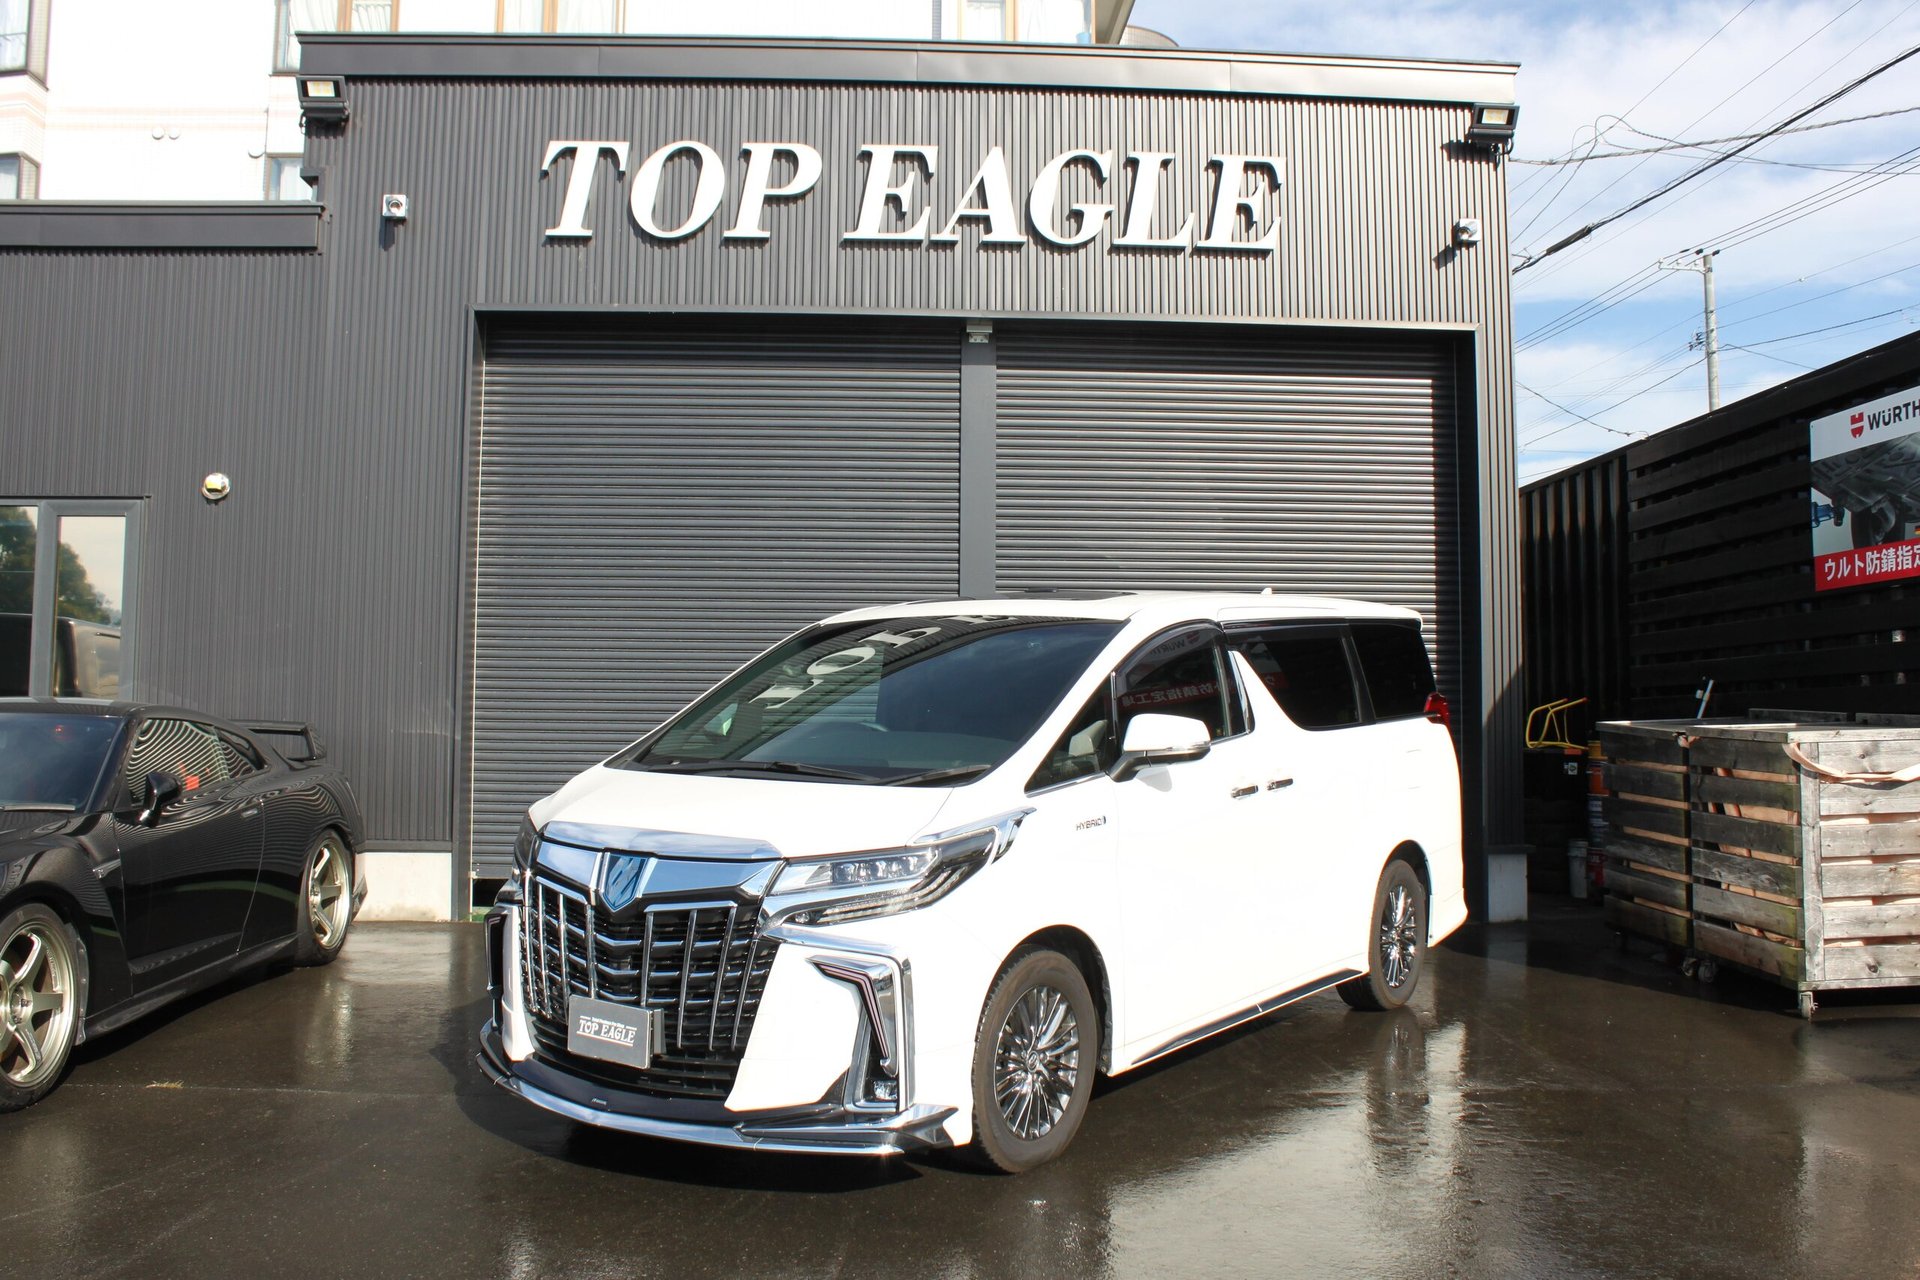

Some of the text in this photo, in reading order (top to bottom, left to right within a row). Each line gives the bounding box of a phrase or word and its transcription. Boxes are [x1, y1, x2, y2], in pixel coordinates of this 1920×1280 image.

[540, 139, 1287, 253] TOP EAGLE
[1076, 818, 1103, 831] HYBRID
[579, 1019, 599, 1035] TOP
[600, 1025, 636, 1043] EAGLE
